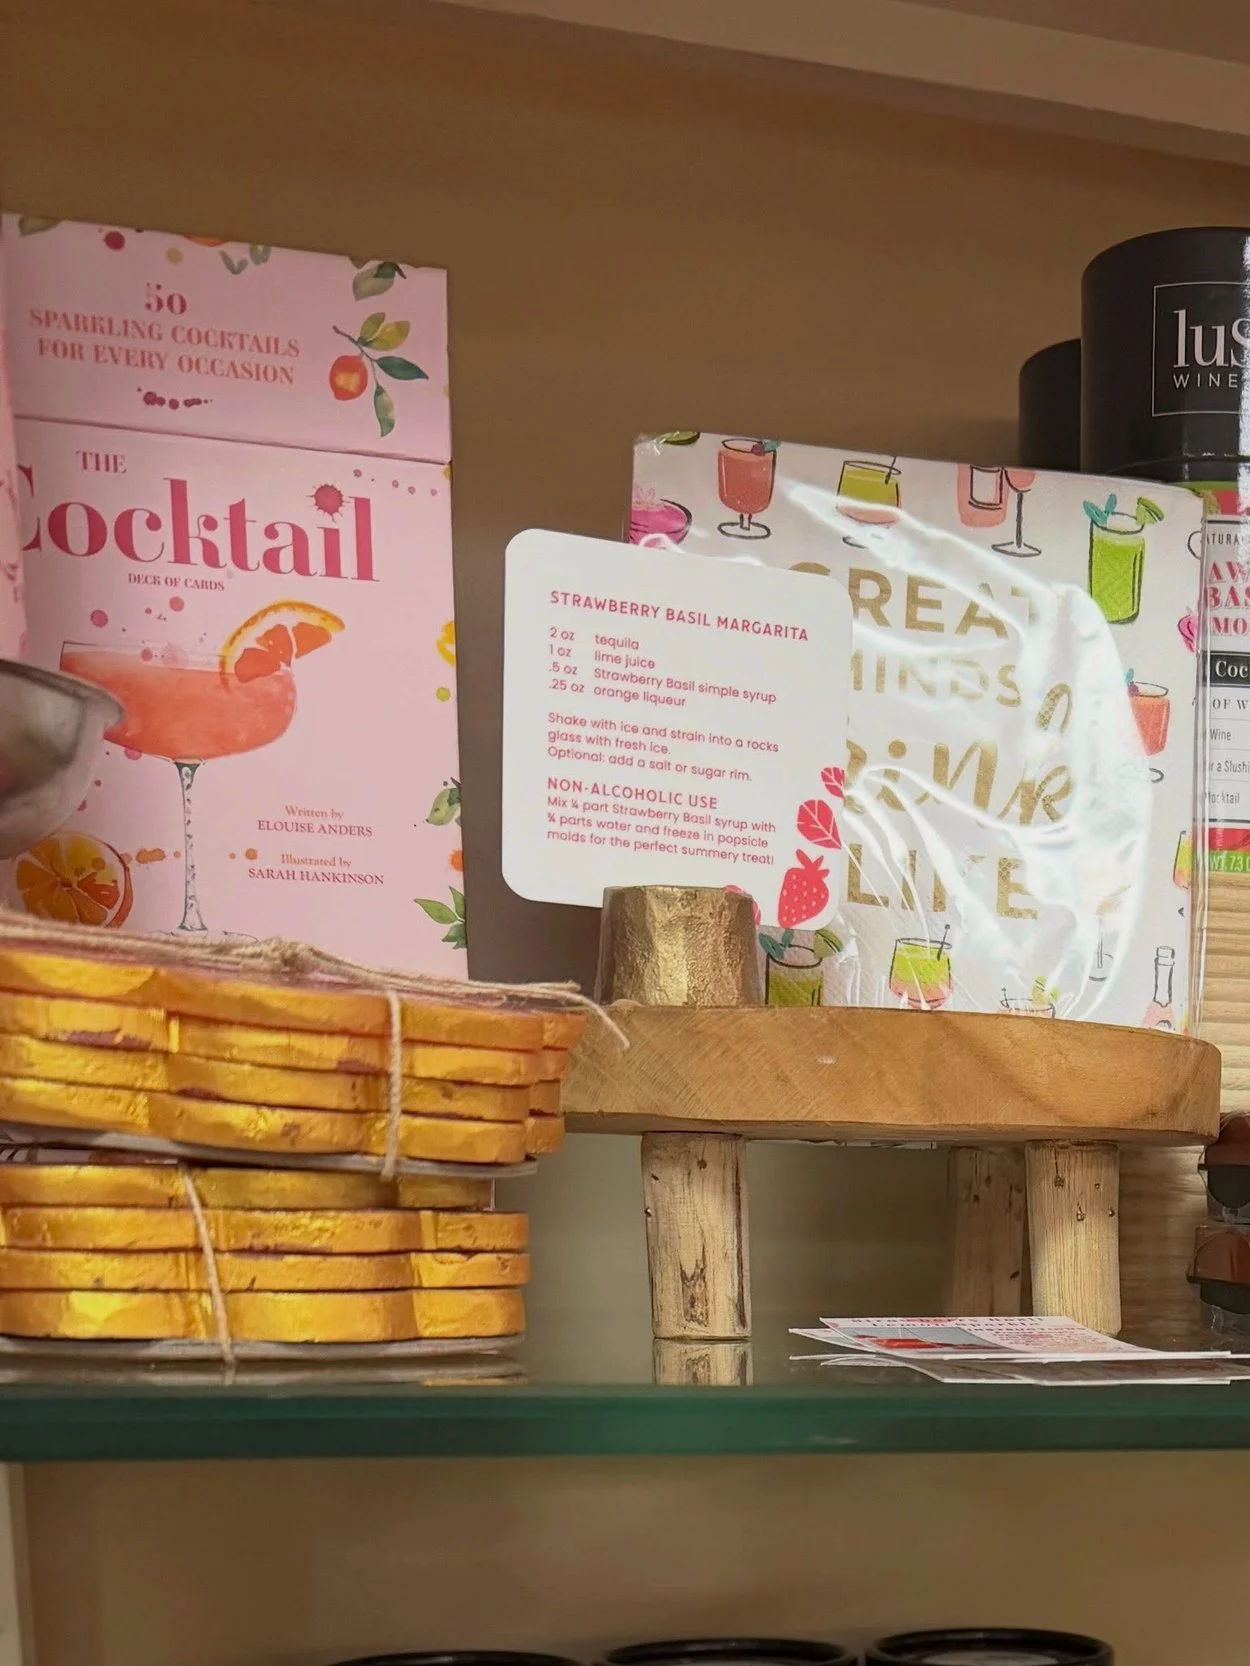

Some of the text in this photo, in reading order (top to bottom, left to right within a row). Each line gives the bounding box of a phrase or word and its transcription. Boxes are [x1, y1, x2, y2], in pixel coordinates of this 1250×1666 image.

[144, 283, 187, 315] 50
[29, 309, 300, 359] SPARKLING COCKTAILS
[38, 338, 294, 386] FOR EVERY OCCASION
[1173, 373, 1238, 390] WINE
[76, 451, 126, 475] THE
[128, 572, 226, 592] DECK OF CARDS
[550, 590, 809, 641] STRAWBERRY BASIL MARGARITA
[594, 633, 640, 651] tequila
[594, 649, 656, 670] lime juice
[593, 686, 687, 707] orange liqueur
[594, 667, 777, 705] Strawberry Basil simple syrup
[547, 777, 718, 810] NON-ALCOHOLIC USE
[256, 819, 373, 838] ELOUISE ANDERS
[248, 866, 385, 885] SARAH HANKINSON
